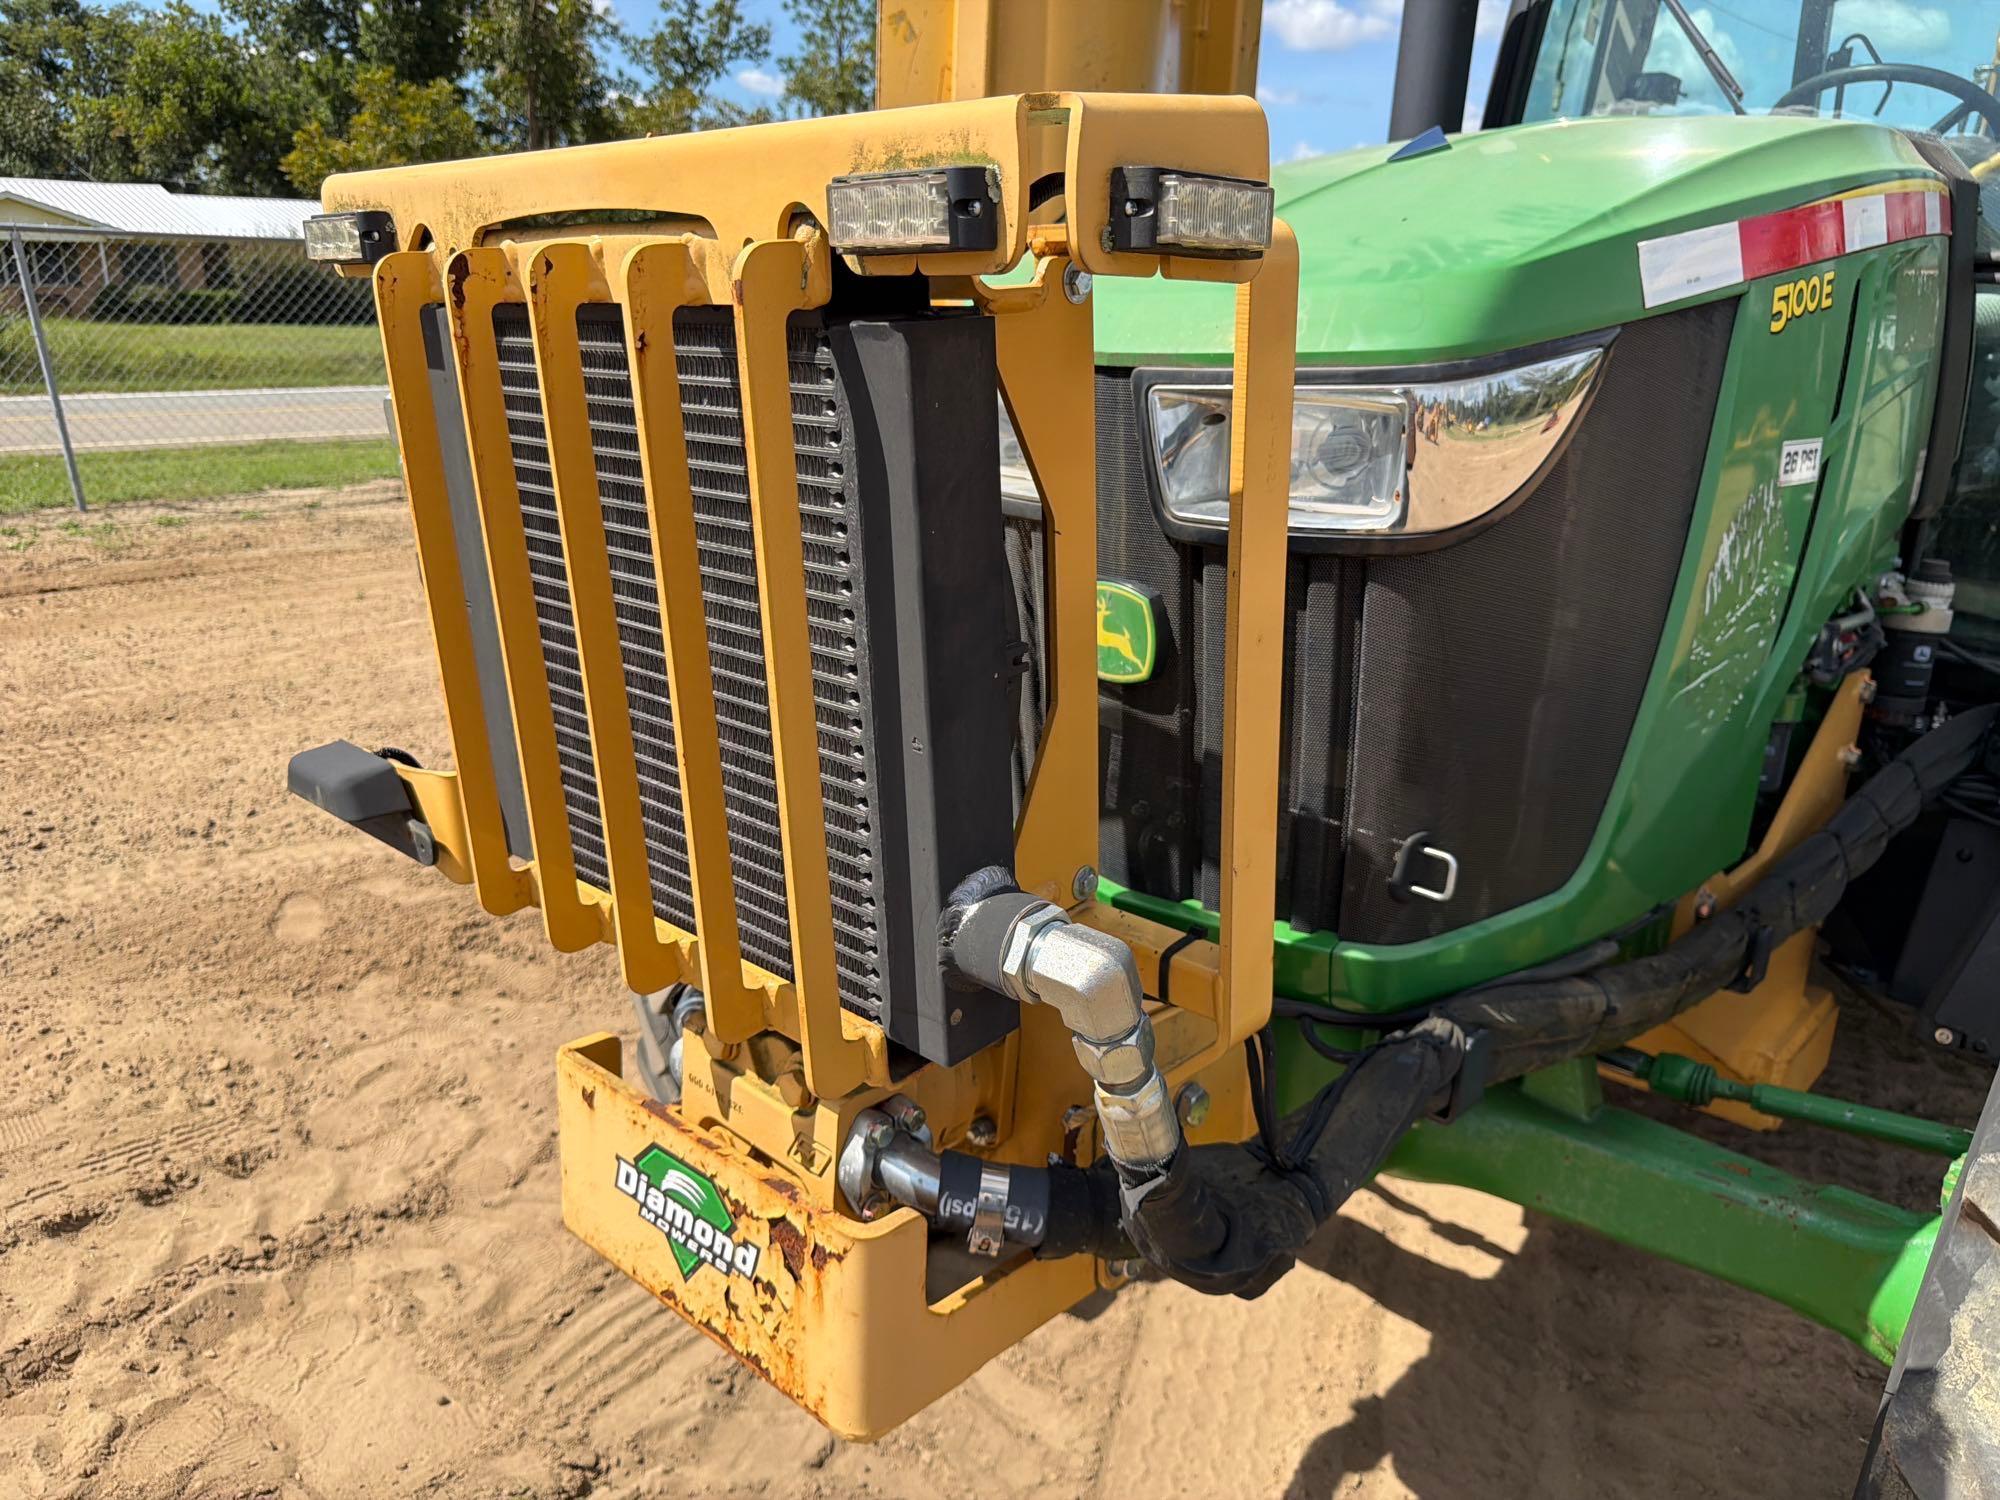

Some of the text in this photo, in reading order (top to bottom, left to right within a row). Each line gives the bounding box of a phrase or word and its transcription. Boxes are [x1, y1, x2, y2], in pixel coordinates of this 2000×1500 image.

[1770, 270, 1836, 334] 5100E
[1783, 448, 1819, 475] 26 PSI
[615, 1157, 759, 1278] Diamond
[640, 1207, 728, 1273] MOWERS
